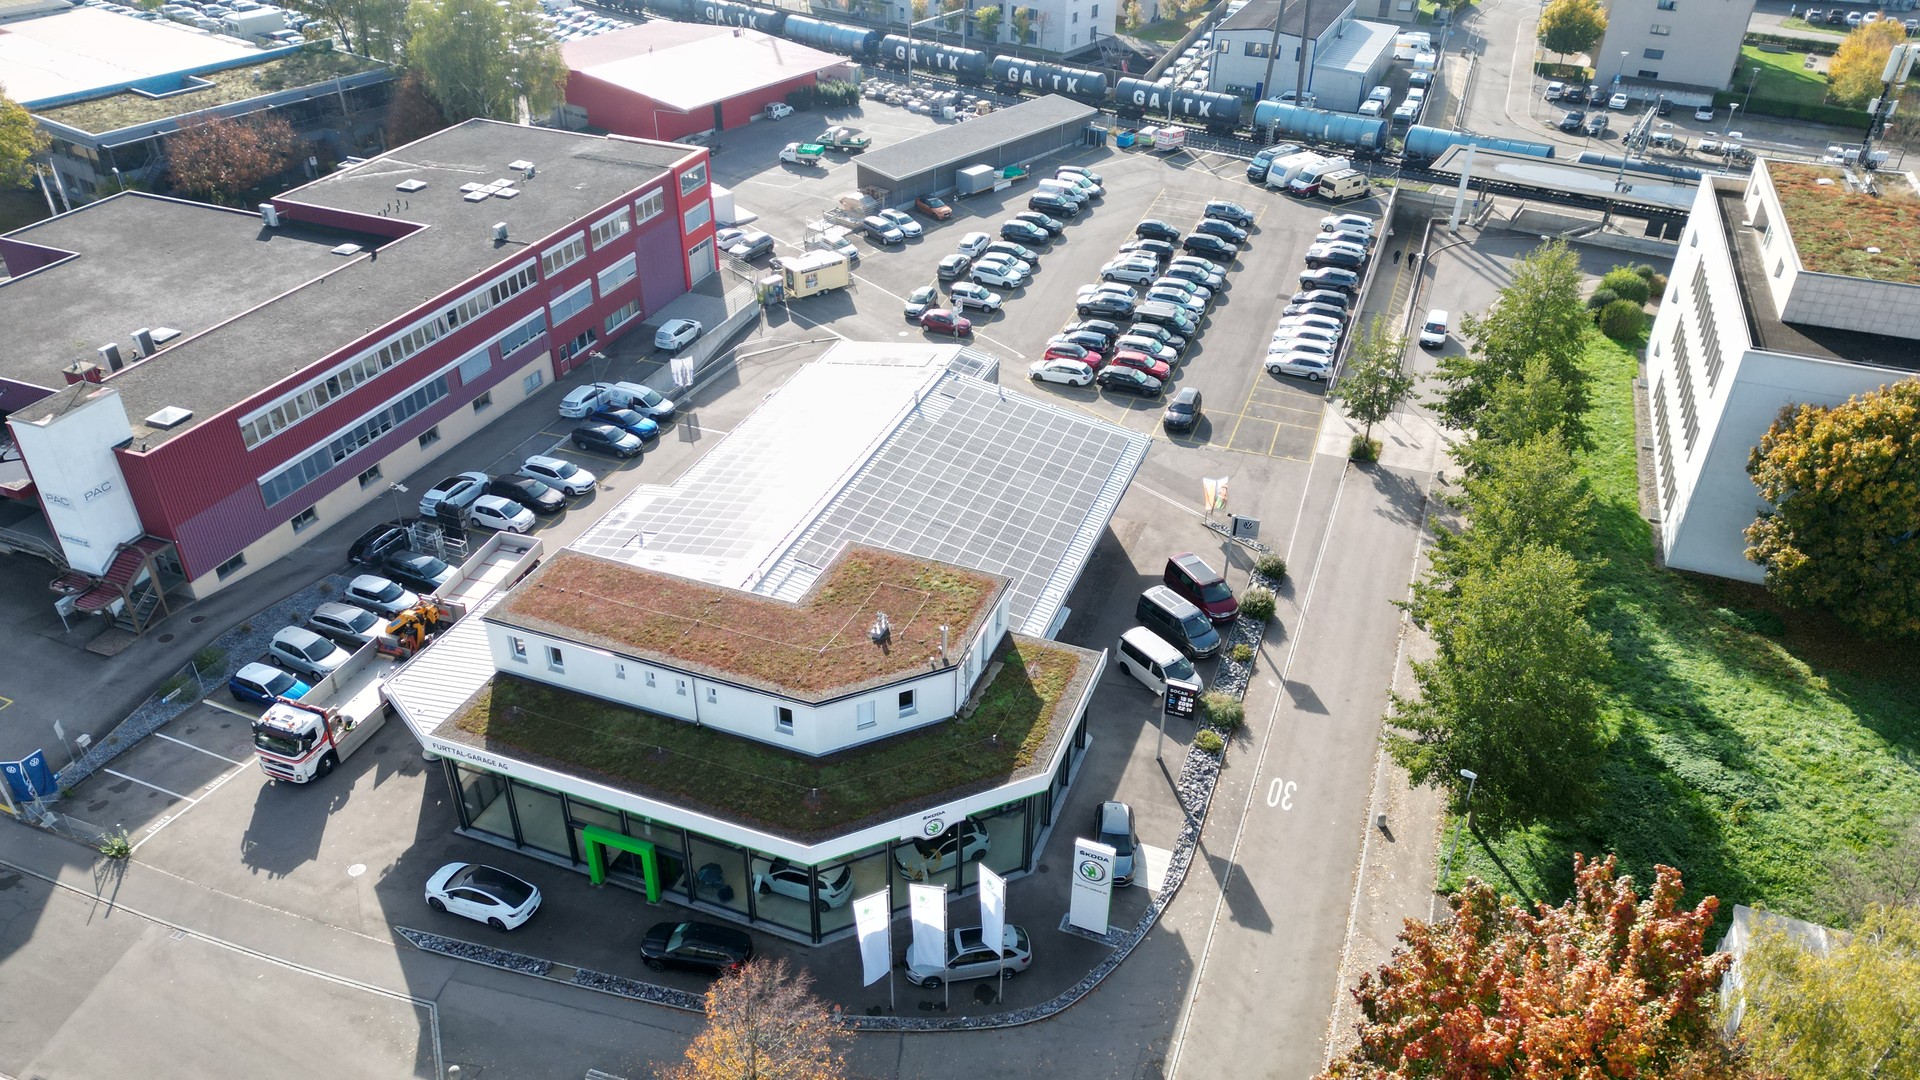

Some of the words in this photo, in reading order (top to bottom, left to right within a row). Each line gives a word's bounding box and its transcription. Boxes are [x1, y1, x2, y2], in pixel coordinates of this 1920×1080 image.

[84, 481, 112, 501] PAC
[45, 493, 70, 506] PAC
[1170, 688, 1189, 697] SOCAR
[432, 742, 497, 767] FURTTAL-GARAGE
[498, 762, 509, 770] AG
[1267, 777, 1297, 811] 30
[1079, 850, 1110, 863] ŠKODA
